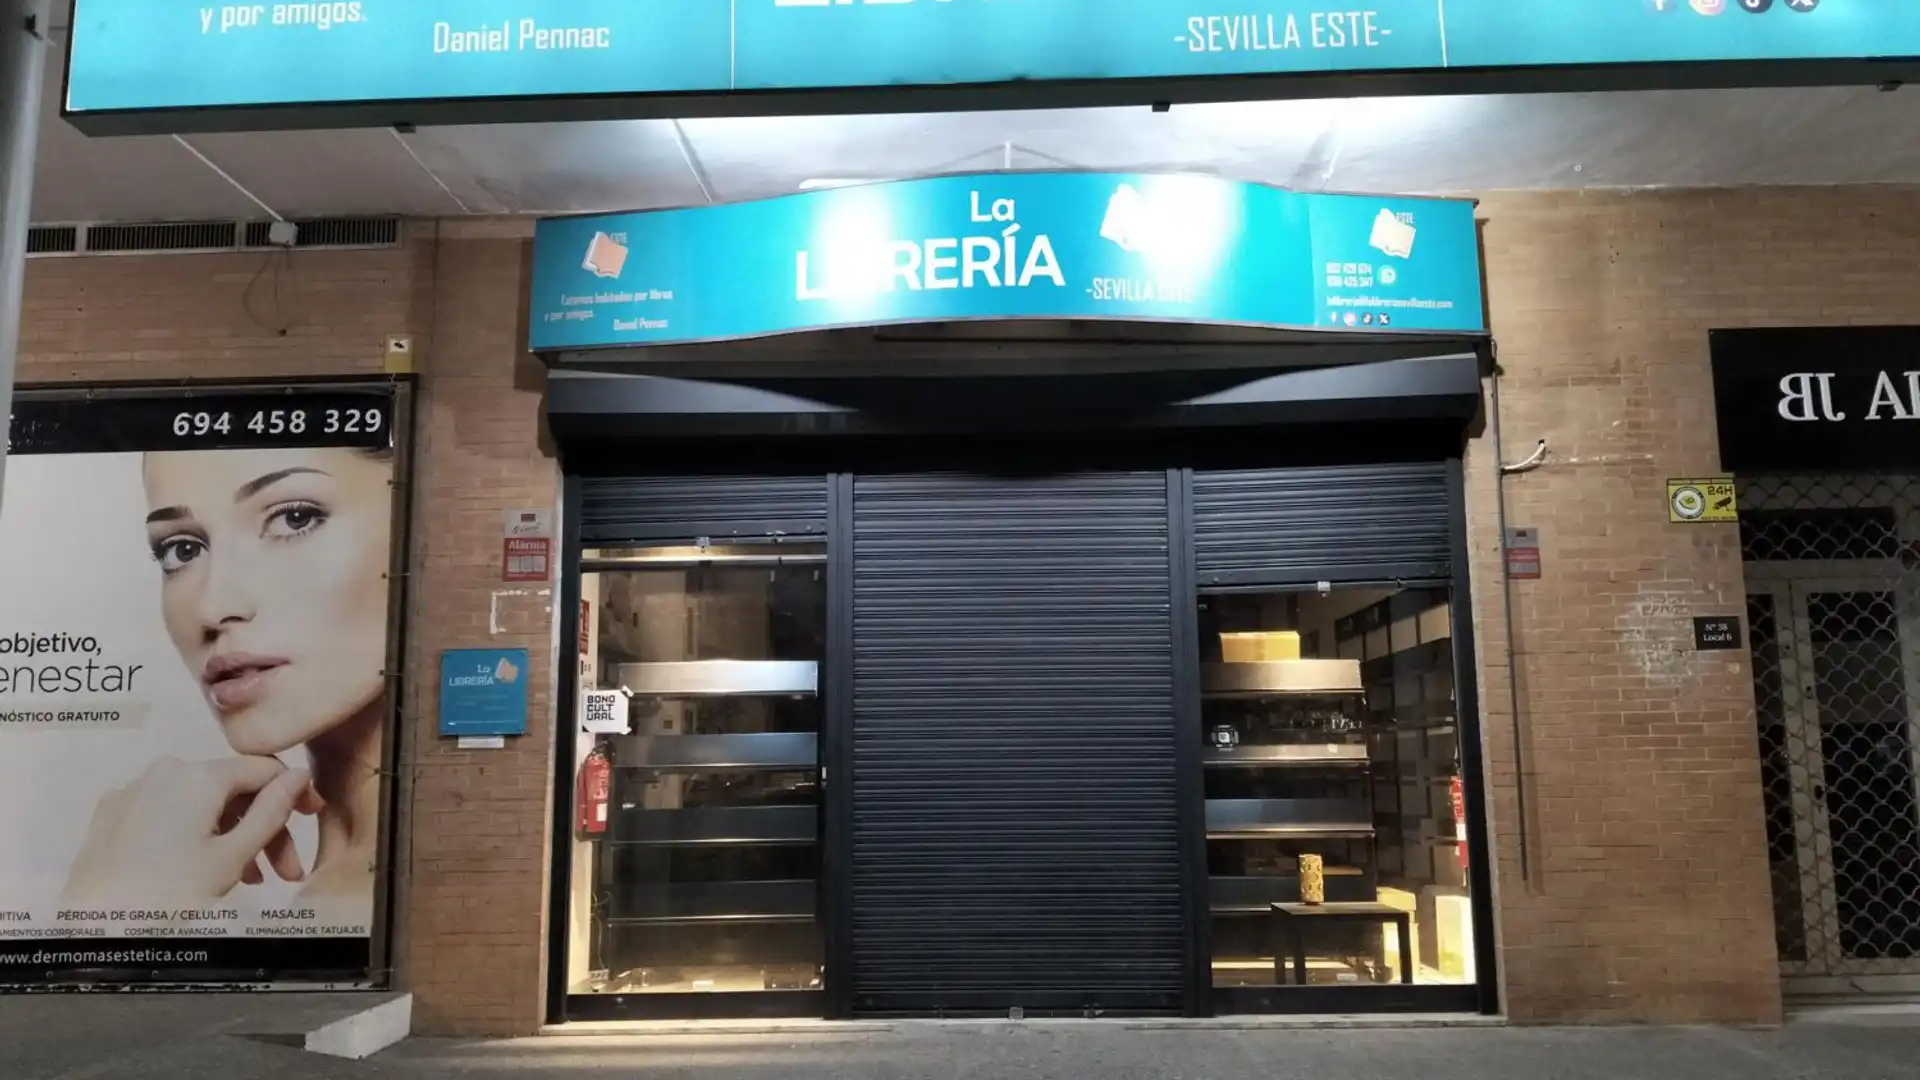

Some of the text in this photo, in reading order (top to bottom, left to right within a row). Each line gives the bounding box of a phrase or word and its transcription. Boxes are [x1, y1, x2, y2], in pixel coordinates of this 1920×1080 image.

[200, 1, 368, 35] y por amigos.
[433, 18, 610, 53] Daniel Pennac
[1174, 11, 1392, 52] -SEVILLA ESTE-
[970, 191, 1015, 222] La
[795, 224, 1067, 301] LRERÍA
[173, 408, 382, 436] 694 458 329
[1707, 485, 1734, 495] 24H
[1703, 633, 1725, 641] Local
[0, 632, 102, 657] objetivo,
[587, 695, 615, 703] BONO
[587, 704, 614, 712] CULT
[57, 711, 120, 721] GRATUITO
[0, 911, 31, 921] ITIVA
[110, 911, 126, 920] DE
[129, 910, 168, 920] GRASA
[180, 909, 238, 920] CELULITIS
[260, 909, 315, 919] MASAJES
[305, 926, 318, 935] DE
[320, 926, 365, 934] TATUAJES
